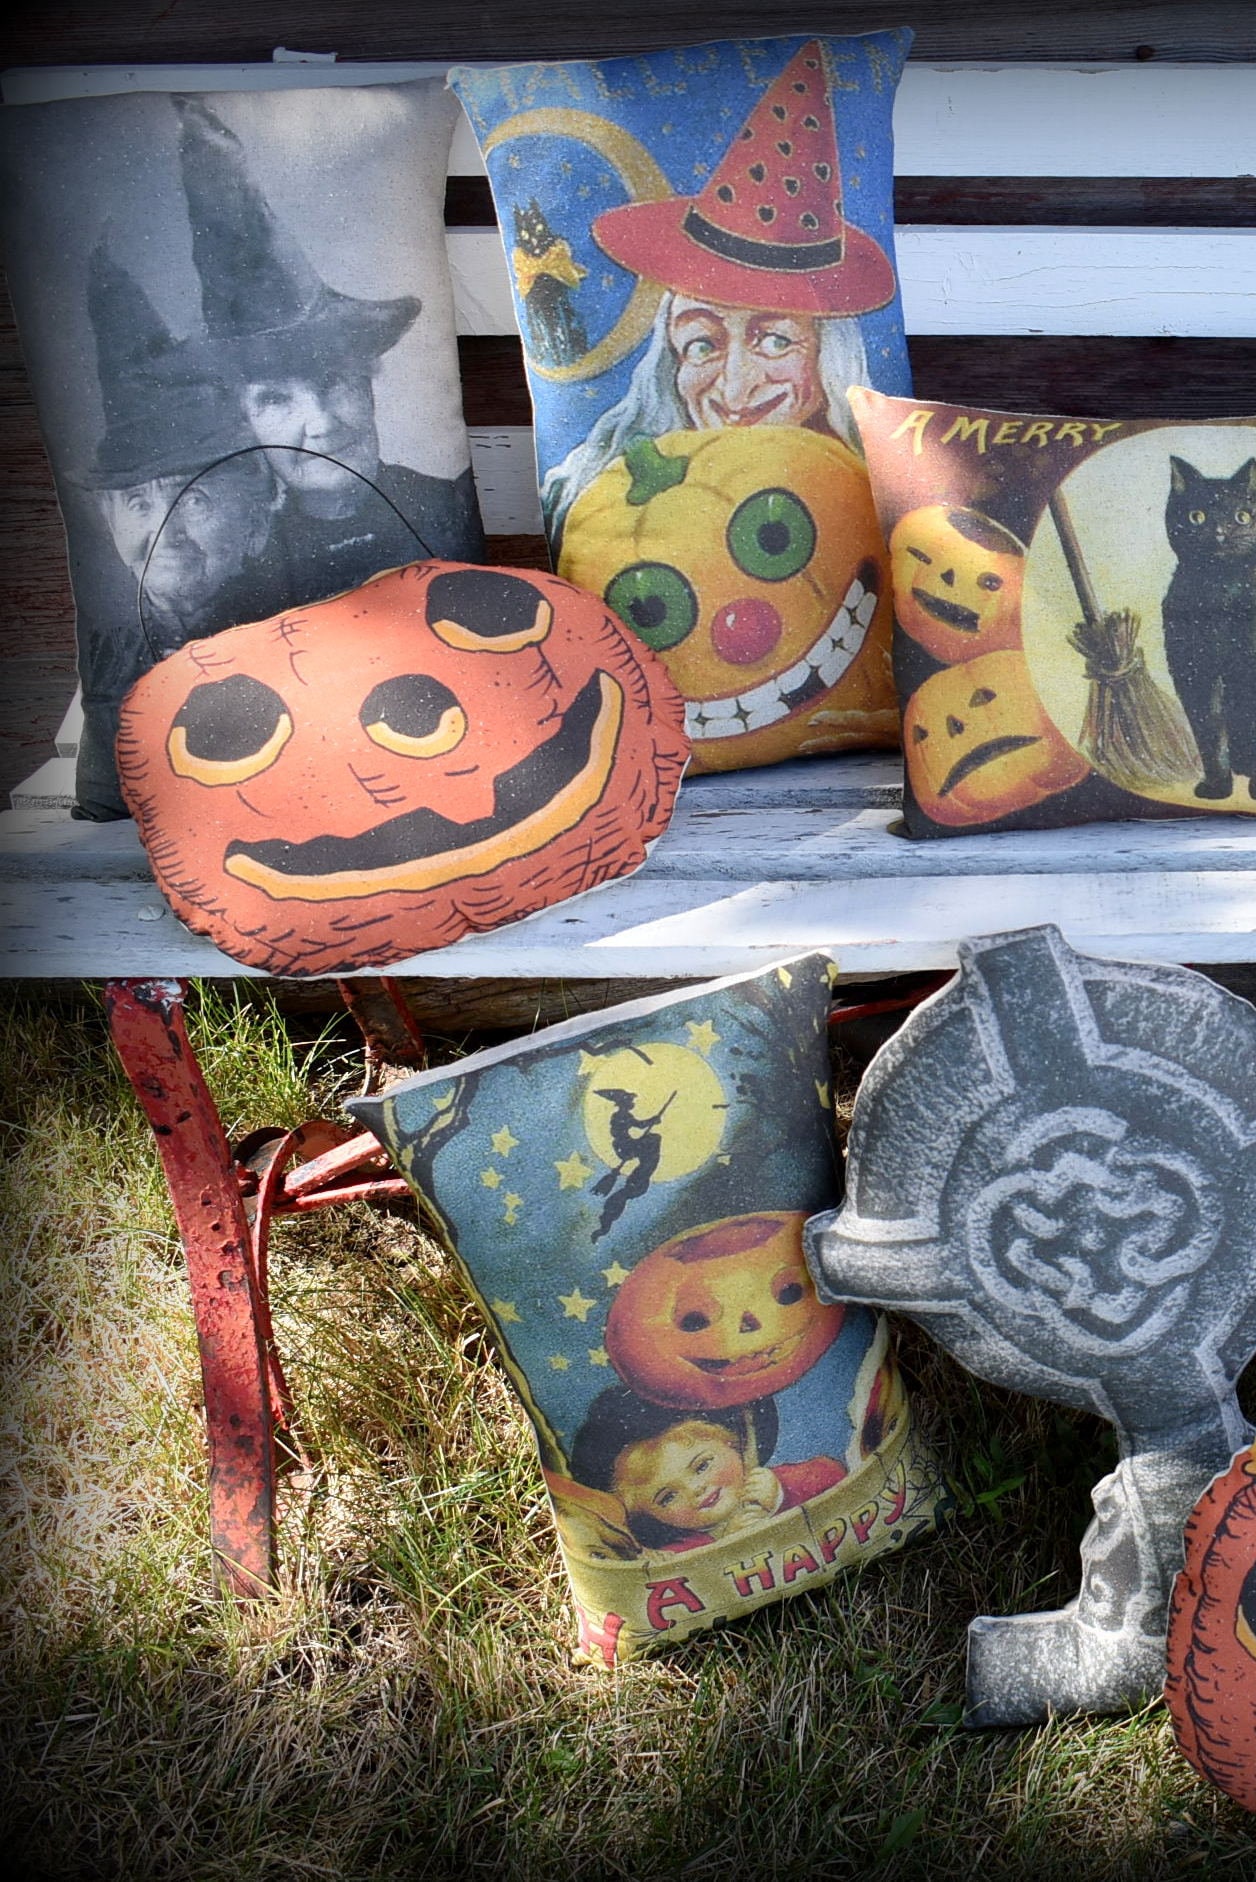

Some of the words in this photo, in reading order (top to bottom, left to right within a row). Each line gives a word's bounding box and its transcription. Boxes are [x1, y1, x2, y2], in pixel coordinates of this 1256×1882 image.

[889, 410, 936, 456] A
[940, 416, 1122, 454] MERRY
[645, 1576, 706, 1631] A
[724, 1458, 907, 1598] HAPPY
